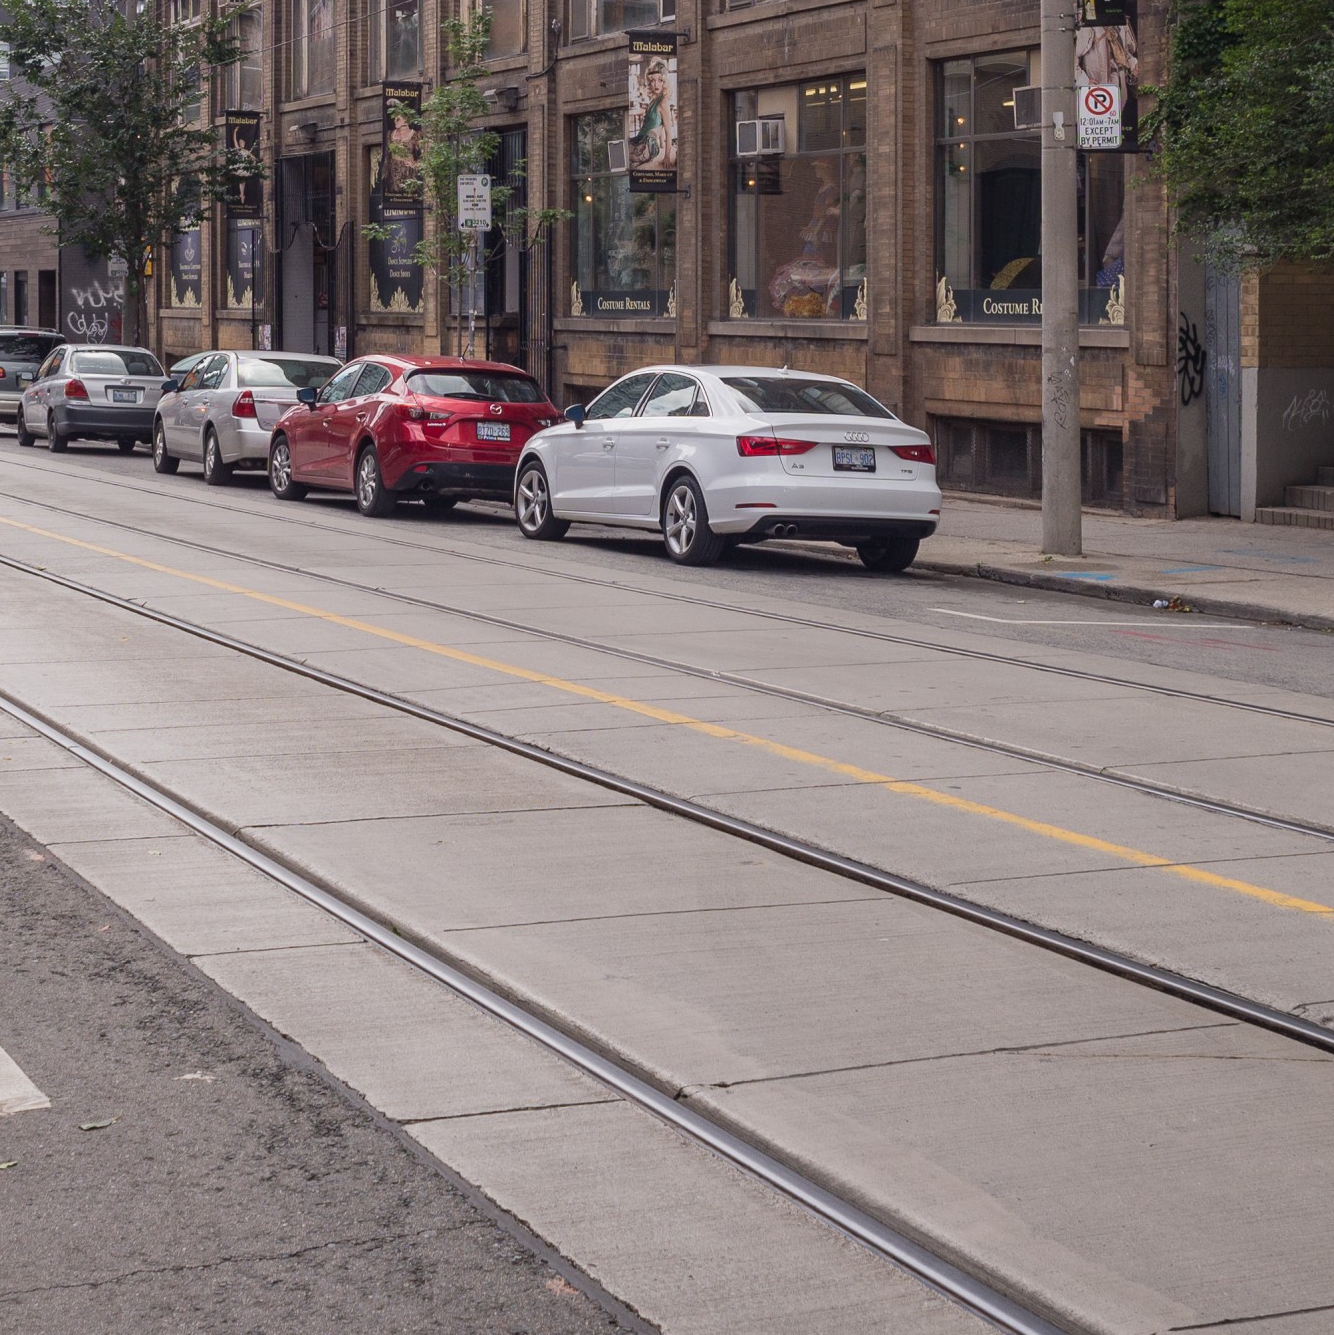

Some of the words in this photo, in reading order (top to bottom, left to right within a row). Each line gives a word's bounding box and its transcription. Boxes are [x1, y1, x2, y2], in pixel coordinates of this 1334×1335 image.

[632, 41, 674, 53] Malabar
[385, 88, 419, 98] Malabar
[1085, 126, 1114, 135] EXCEPT
[1081, 136, 1091, 145] BY
[1092, 135, 1119, 145] PERMIT
